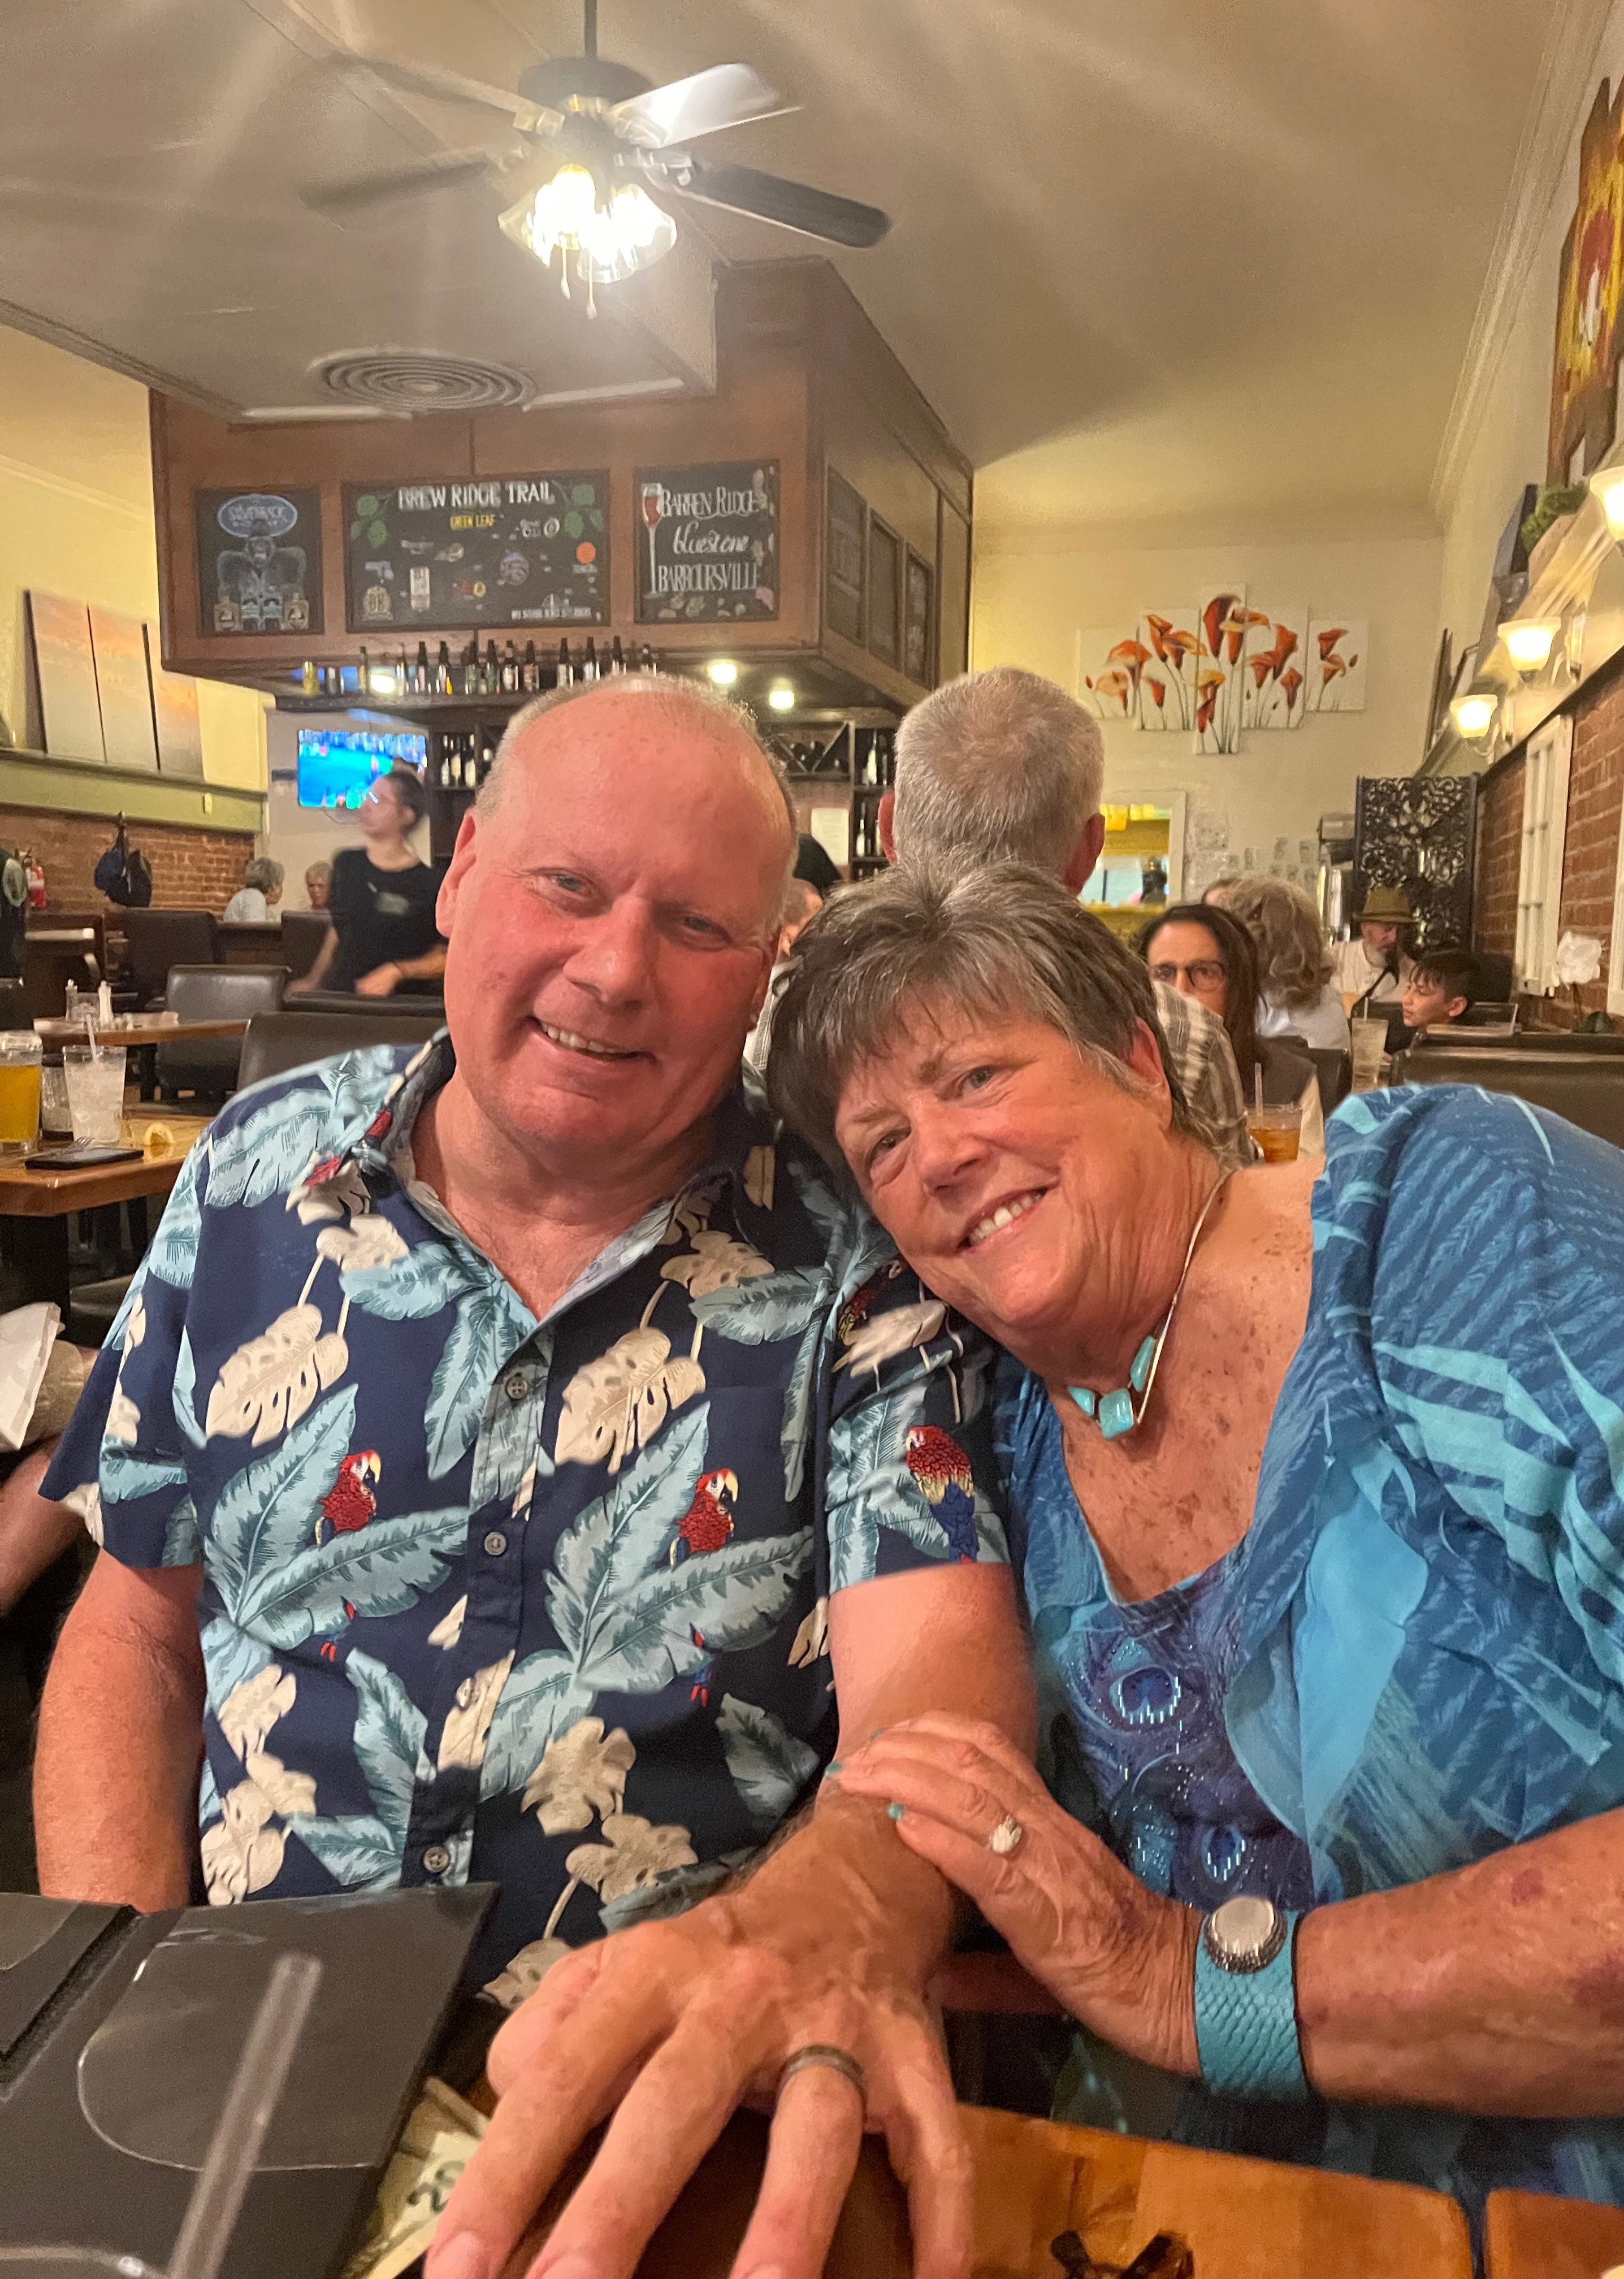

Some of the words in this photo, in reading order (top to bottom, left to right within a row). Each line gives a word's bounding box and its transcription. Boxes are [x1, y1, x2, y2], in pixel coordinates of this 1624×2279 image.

[398, 485, 446, 510] BREW
[452, 482, 501, 508] RIDGE
[505, 480, 555, 504] TRAIL
[661, 489, 712, 517] BARREN
